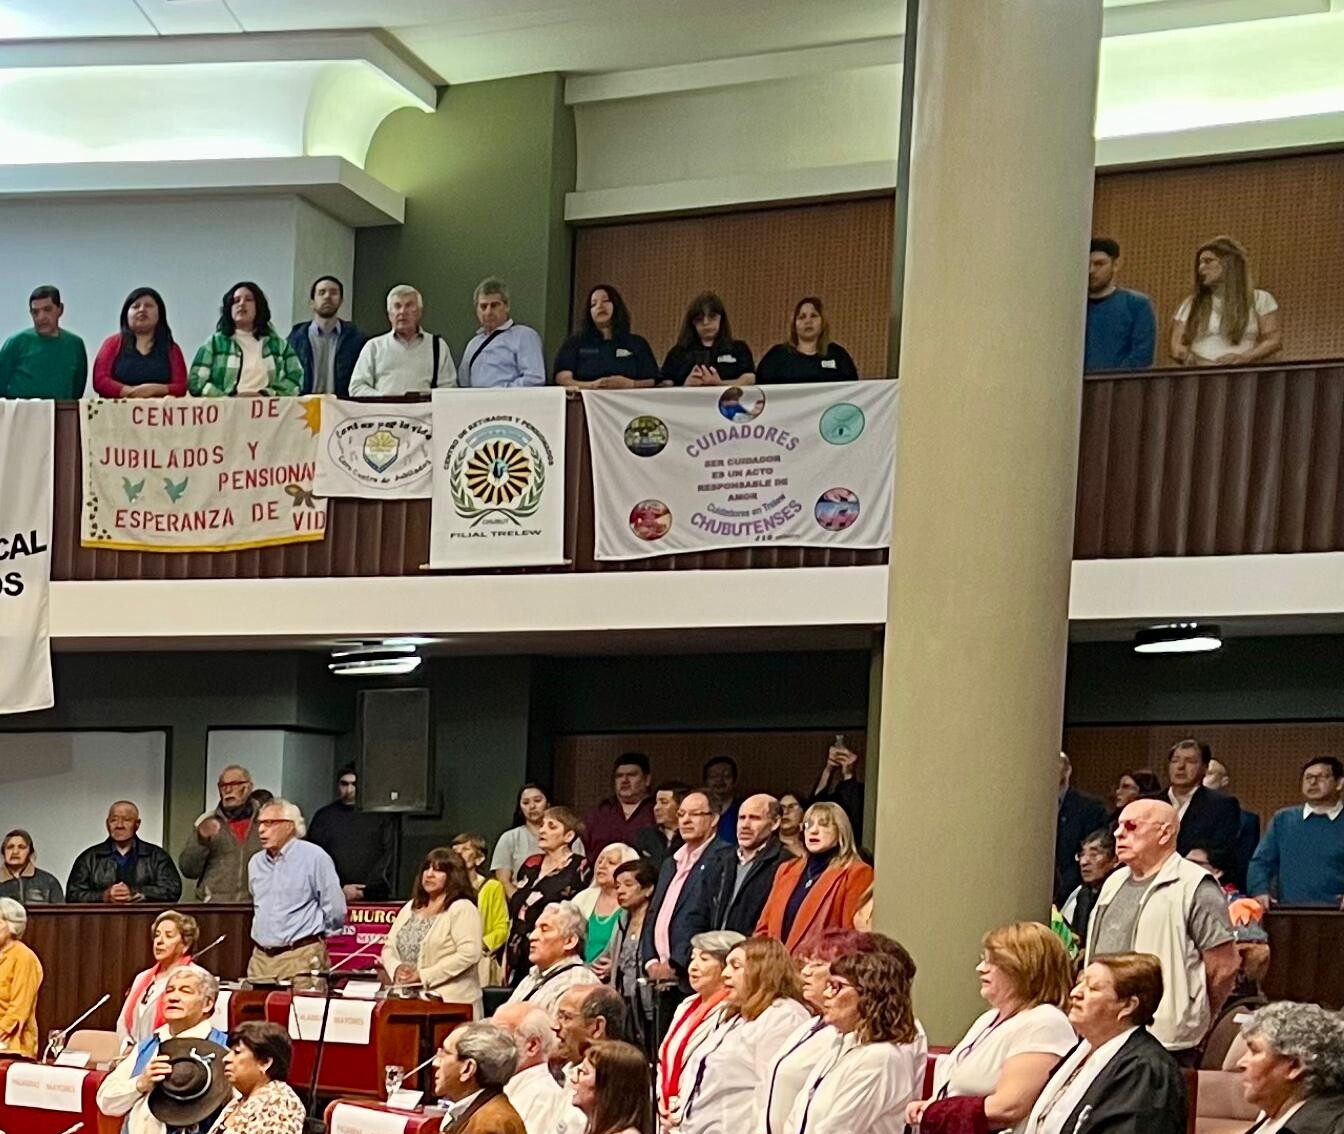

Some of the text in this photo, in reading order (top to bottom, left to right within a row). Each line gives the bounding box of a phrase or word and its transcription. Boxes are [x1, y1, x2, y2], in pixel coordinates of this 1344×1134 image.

[132, 398, 280, 427] CENTRO DE
[100, 441, 260, 470] JUBILADOS Y
[686, 424, 800, 458] CUIDADORES
[704, 455, 781, 468] SER CUIDADOR
[712, 468, 774, 479] ES UN ACTO
[218, 461, 316, 492] PENSIONA
[697, 478, 788, 492] RESPONSABLE DE
[727, 492, 758, 502] AMOR
[114, 508, 234, 533] ESPERANZA
[252, 501, 280, 522] DE
[690, 499, 802, 536] CHUBUTENSES
[450, 529, 542, 539] FILIAL TRELEW
